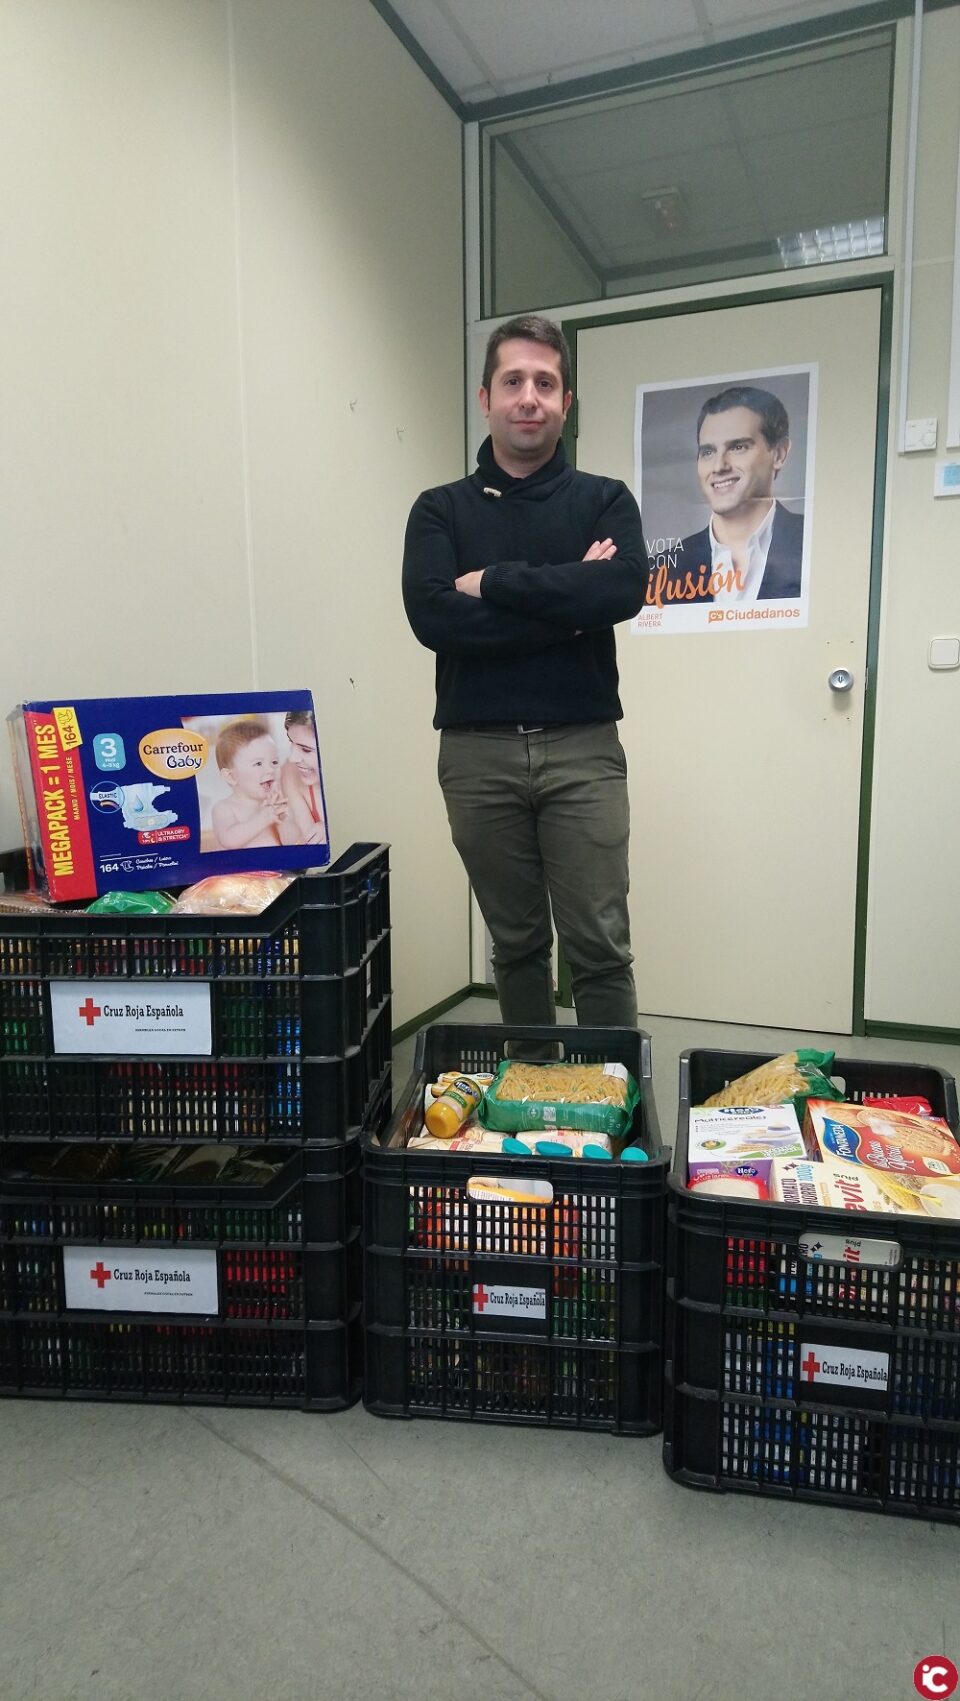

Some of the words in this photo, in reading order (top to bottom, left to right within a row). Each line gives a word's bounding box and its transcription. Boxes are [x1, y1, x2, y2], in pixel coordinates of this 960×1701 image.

[645, 537, 684, 554] VOTA
[647, 554, 678, 570] CON
[645, 563, 745, 609] ilusión
[638, 613, 663, 621] ALBERT
[726, 608, 800, 621] Ciudadanos
[62, 724, 77, 747] 164
[100, 737, 117, 758] 3
[143, 742, 204, 755] Carrefour
[40, 764, 61, 774] 1
[166, 756, 202, 769] Baby
[43, 789, 75, 877] MEGAPACK
[100, 863, 119, 873] 164
[103, 1005, 124, 1017] Cruz
[125, 1005, 145, 1020] Roja
[146, 1005, 184, 1020] Española
[833, 1173, 859, 1181] plus
[781, 1178, 801, 1205] ORMATO
[800, 1183, 819, 1206] HORRO
[113, 1269, 133, 1281] Cruz
[135, 1269, 153, 1284] Roja
[154, 1270, 191, 1284] Española
[490, 1292, 504, 1305] Cruz
[505, 1293, 518, 1308] Roja
[519, 1294, 545, 1309] Española
[822, 1361, 839, 1375] Cruz
[840, 1363, 855, 1380] Roja
[857, 1365, 888, 1382] Española
